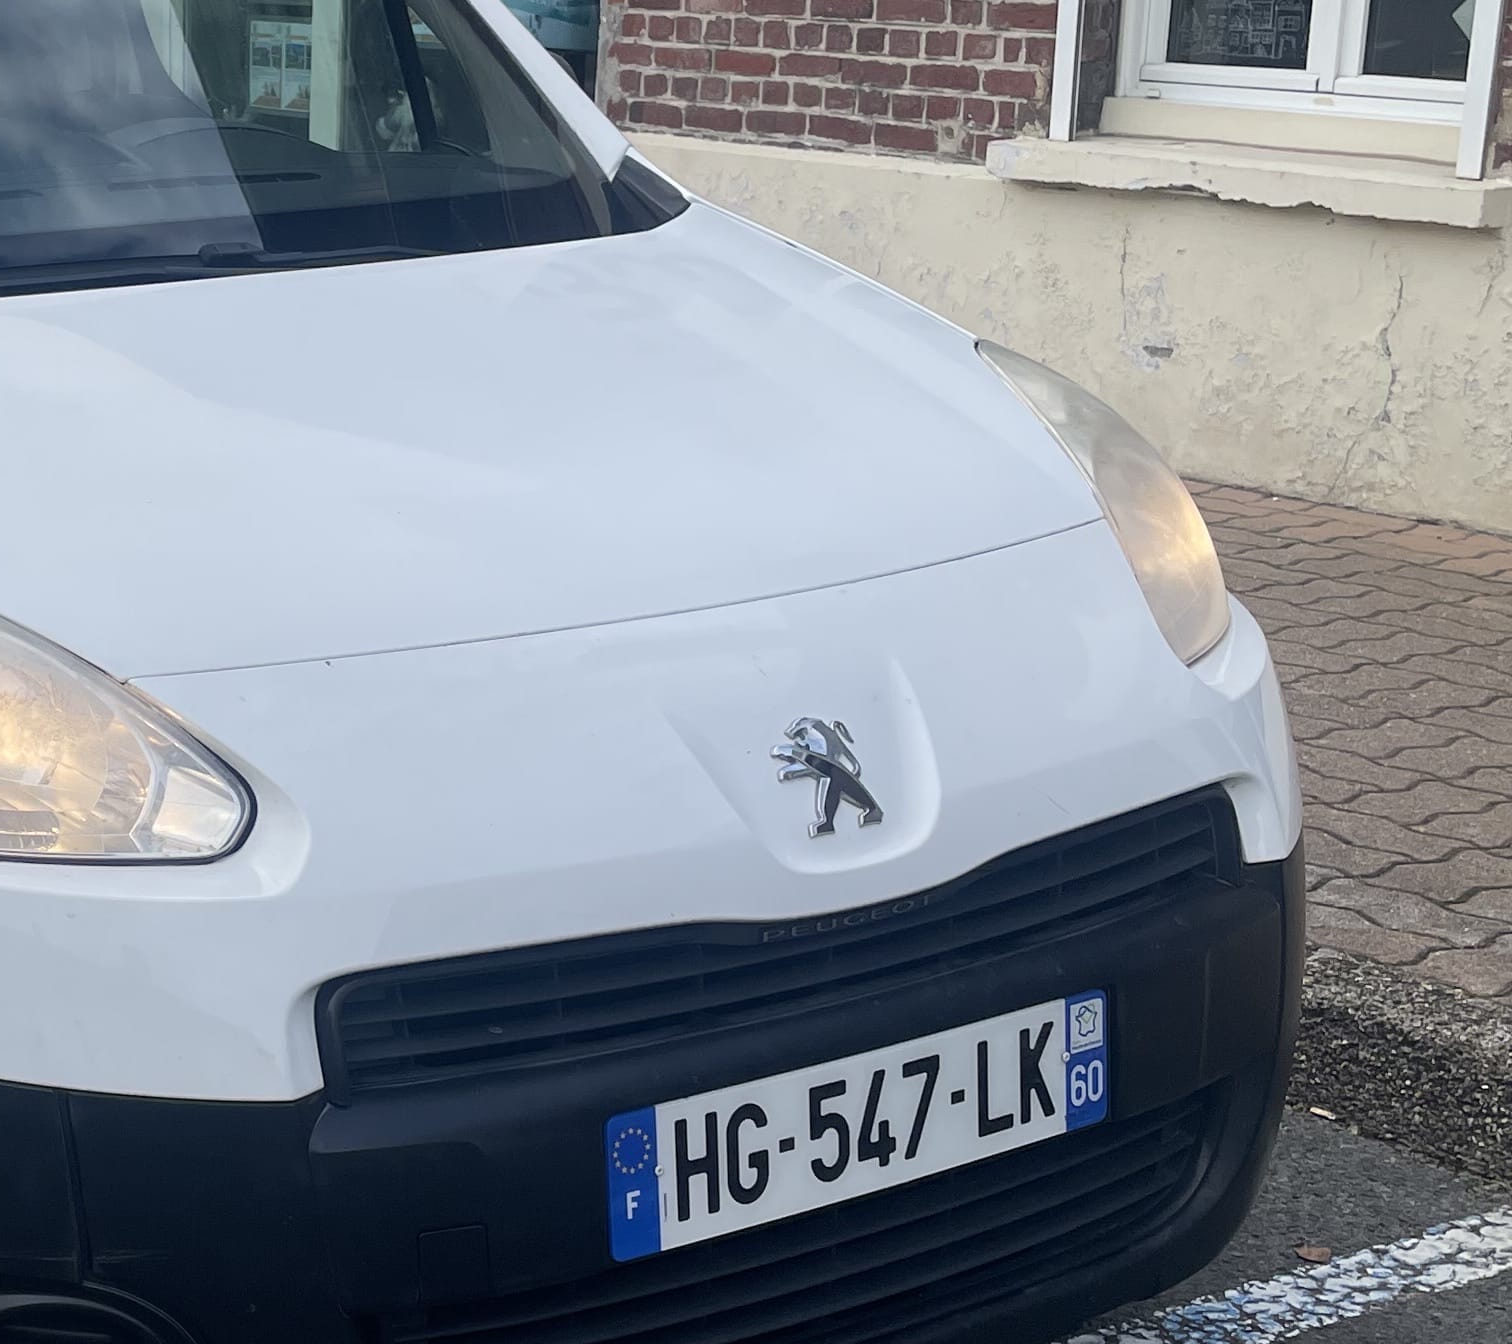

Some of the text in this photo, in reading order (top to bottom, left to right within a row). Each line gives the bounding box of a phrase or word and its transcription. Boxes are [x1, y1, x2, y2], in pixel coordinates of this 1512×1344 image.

[761, 893, 938, 944] PEUGEOT
[1070, 1059, 1104, 1107] 60
[672, 1020, 1057, 1223] HG-547-LK
[626, 1189, 641, 1220] F
